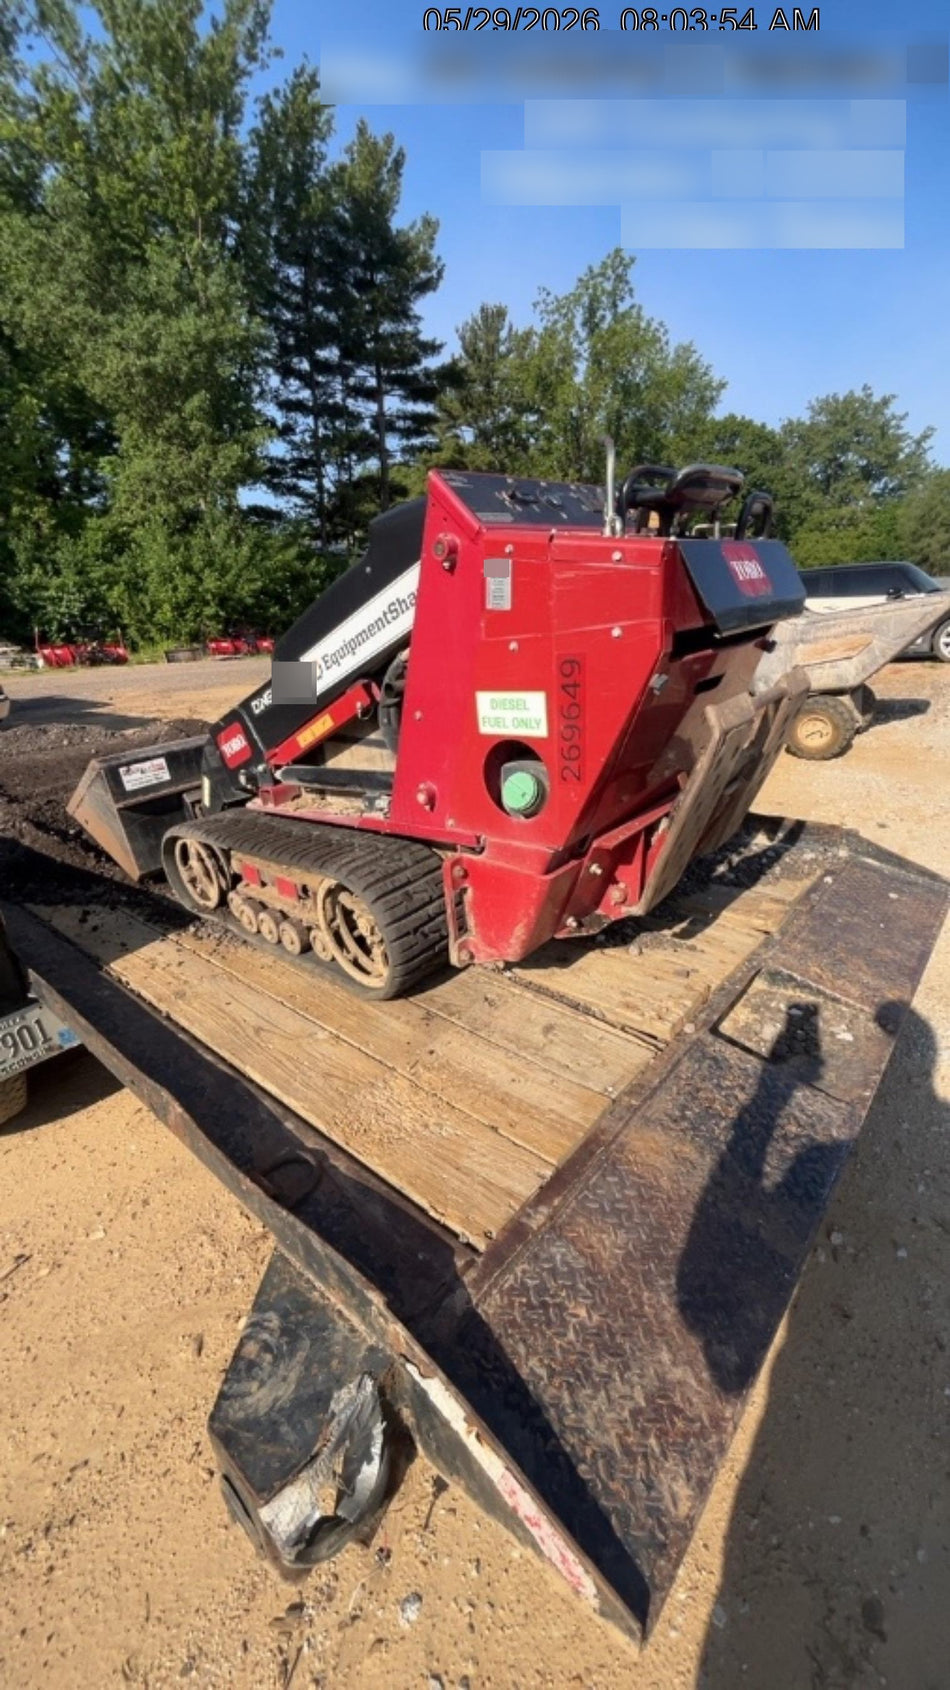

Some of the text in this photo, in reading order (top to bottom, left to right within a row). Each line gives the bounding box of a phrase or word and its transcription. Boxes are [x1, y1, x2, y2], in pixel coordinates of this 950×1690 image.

[730, 560, 765, 581] TORO
[321, 590, 416, 671] EquipmentSha
[489, 698, 530, 711] DIESEL
[560, 658, 581, 782] 269649
[481, 716, 542, 730] FUEL ONLY
[0, 1018, 52, 1065] 901
